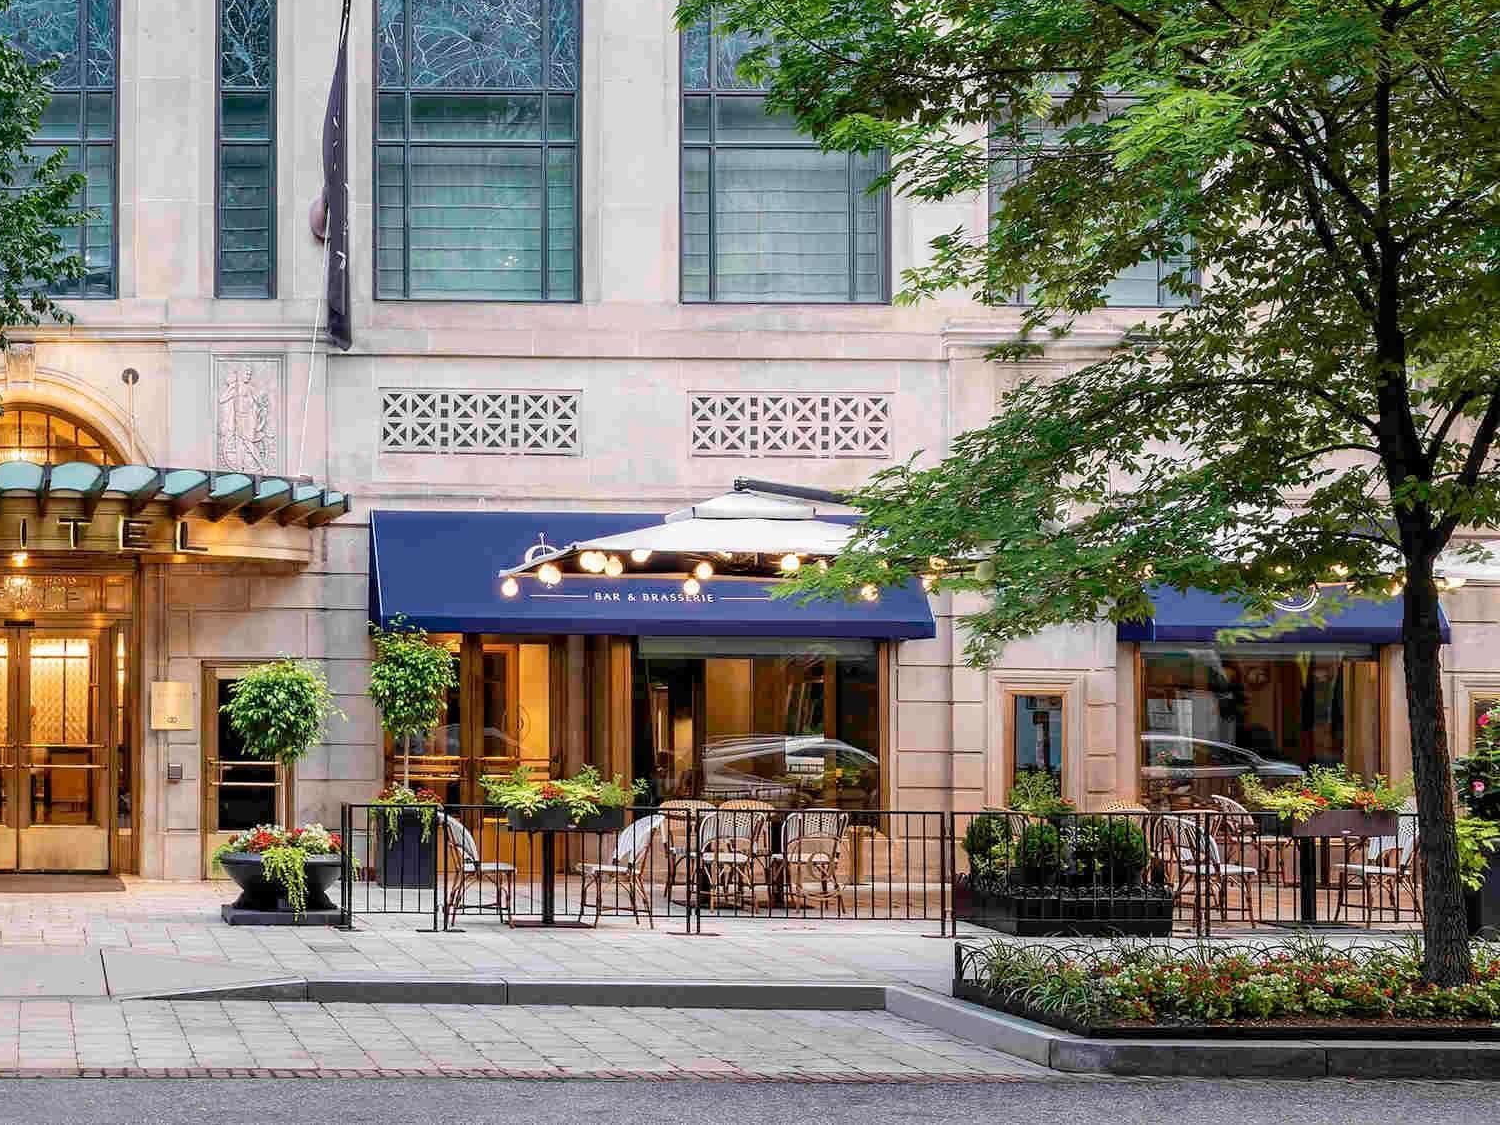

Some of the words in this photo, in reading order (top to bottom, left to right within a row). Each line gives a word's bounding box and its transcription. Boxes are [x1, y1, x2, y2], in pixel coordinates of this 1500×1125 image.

[595, 592, 621, 602] BAR
[627, 593, 637, 602] &
[642, 593, 715, 603] BRASSERIE
